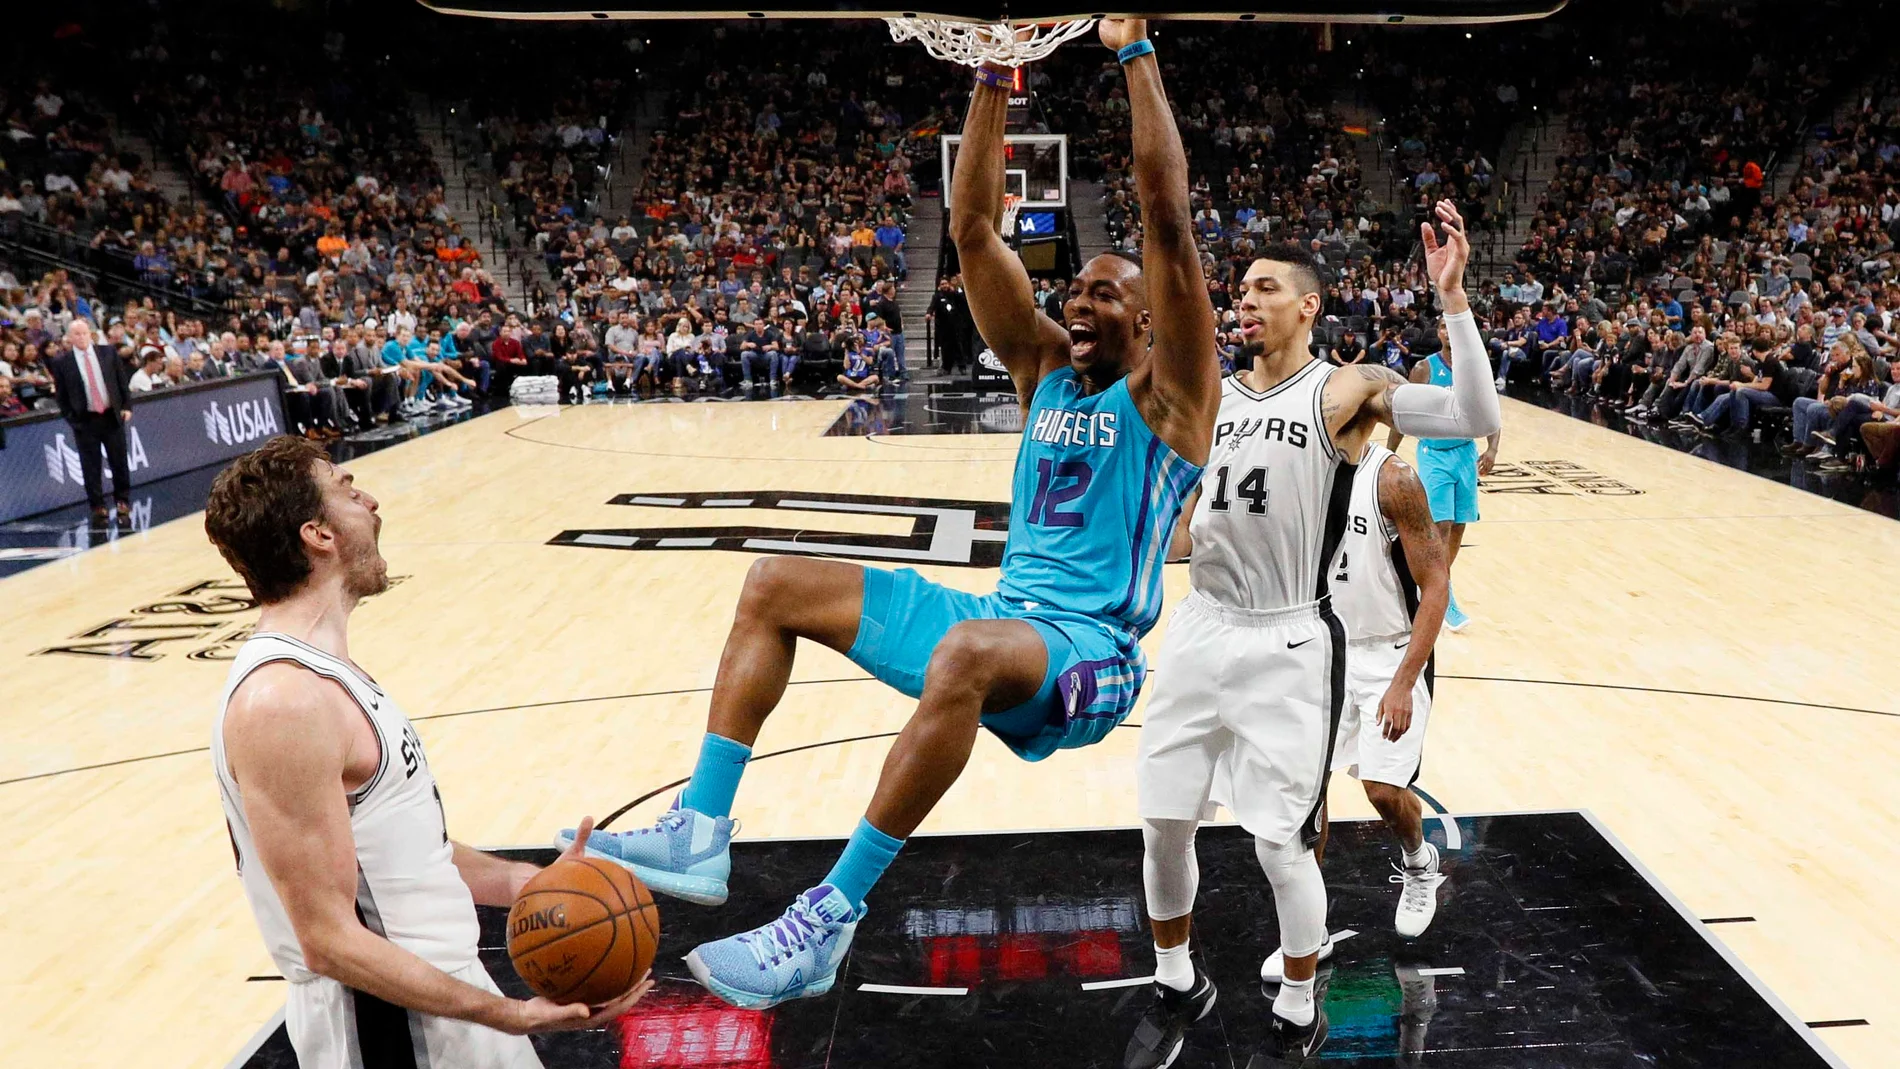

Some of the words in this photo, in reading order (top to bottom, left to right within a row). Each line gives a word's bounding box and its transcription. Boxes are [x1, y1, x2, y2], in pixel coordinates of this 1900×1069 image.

[1008, 97, 1028, 106] SOT
[228, 397, 278, 443] USAA
[1031, 407, 1119, 447] HORETS
[1215, 417, 1309, 451] PURS
[1026, 458, 1094, 527] 12
[1209, 464, 1270, 517] 14
[511, 903, 567, 940] LDING
